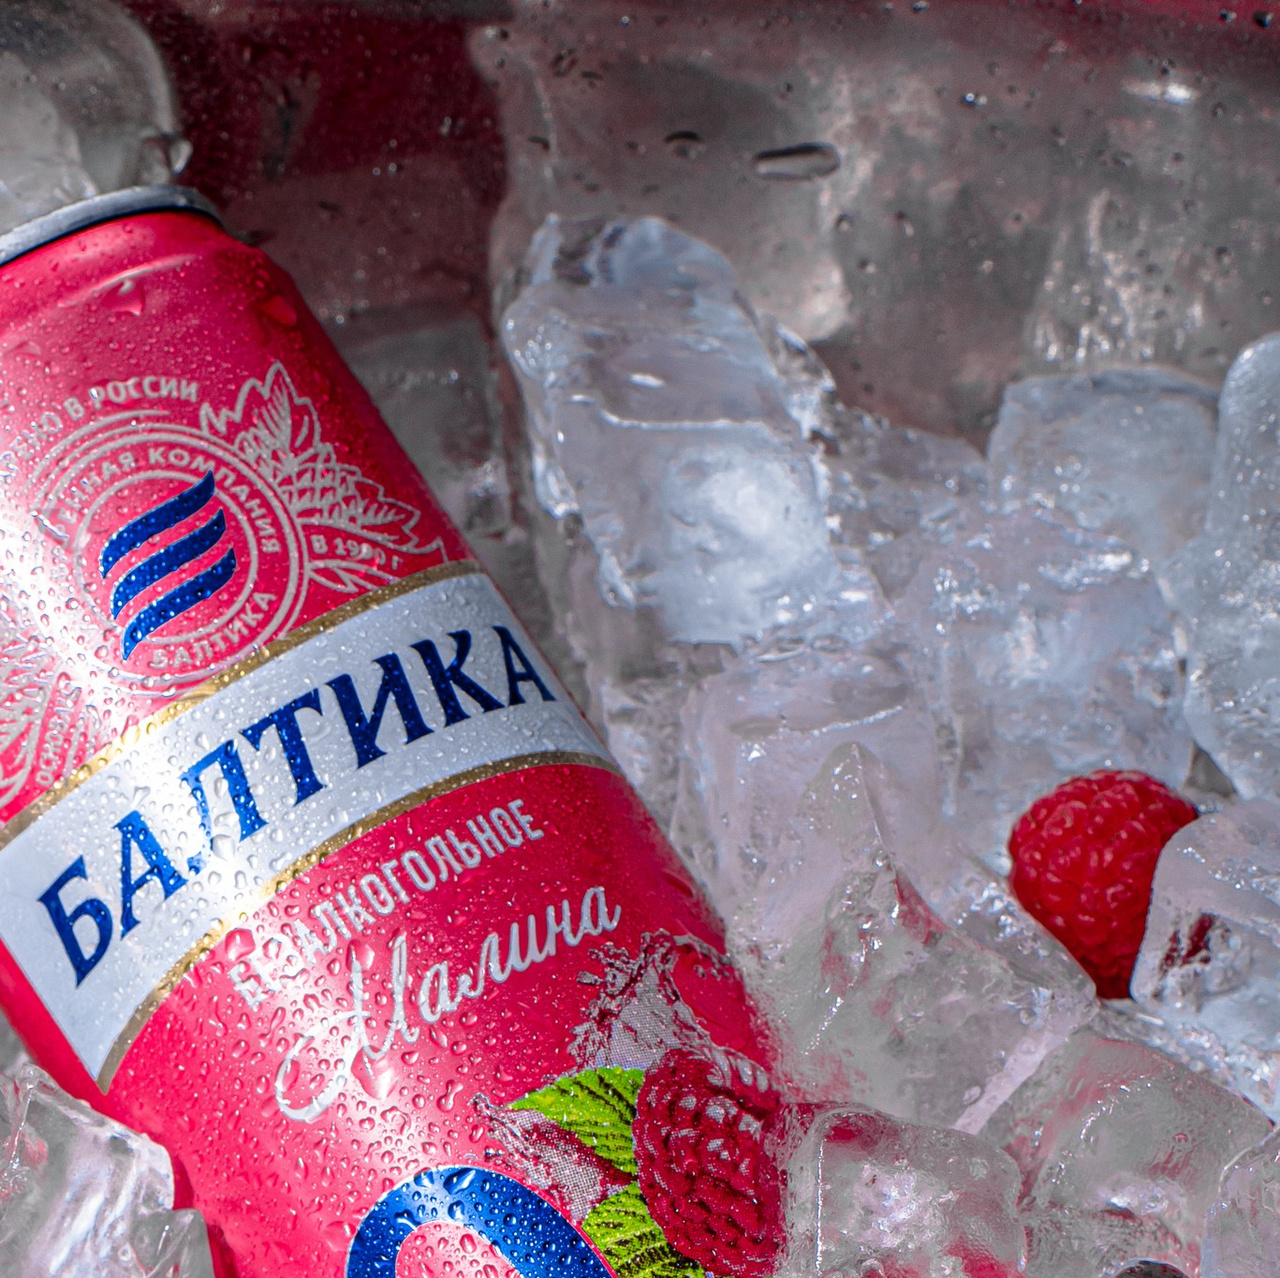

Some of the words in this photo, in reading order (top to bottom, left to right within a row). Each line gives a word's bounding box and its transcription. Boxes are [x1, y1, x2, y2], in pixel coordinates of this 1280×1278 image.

[63, 397, 85, 420] В
[89, 375, 199, 410] РОССИИ
[147, 446, 282, 553] КОМПАНИЯ
[309, 534, 329, 554] В
[150, 590, 276, 670] БАЛТИКА
[37, 625, 556, 988] БАЛТИКА
[226, 798, 545, 1012] БЕЗАЛКОГОЛЬНОЕ
